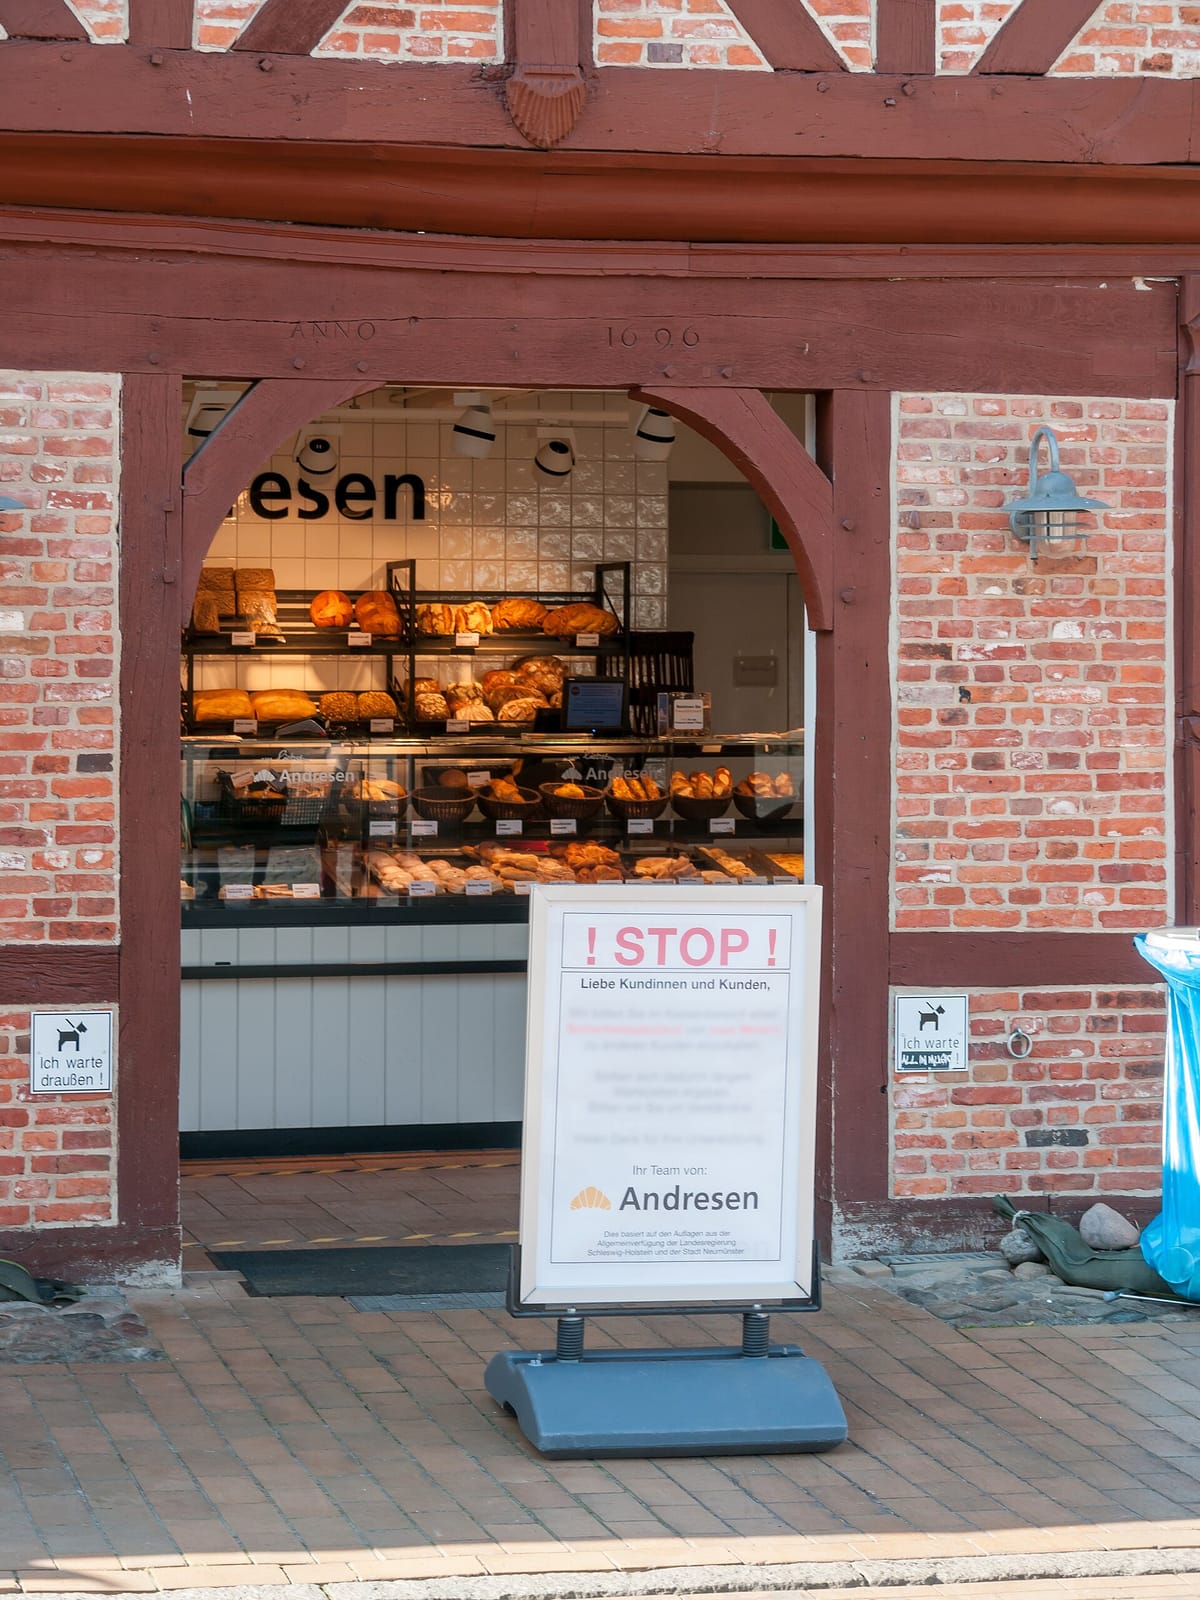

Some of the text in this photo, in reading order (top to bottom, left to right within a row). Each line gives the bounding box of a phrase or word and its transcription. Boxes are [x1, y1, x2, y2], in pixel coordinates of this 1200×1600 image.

[290, 321, 700, 352] ANNO 1696
[229, 471, 426, 520] esen
[587, 926, 777, 967] ! STOP !
[581, 978, 771, 991] Liebe Kundinnen und Kunden,
[903, 1036, 960, 1049] Ich warte
[40, 1057, 104, 1069] Ich warte
[41, 1072, 103, 1087] draußen !
[632, 1164, 708, 1176] Ihr Team von:
[618, 1184, 759, 1211] Andresen
[603, 1230, 620, 1238] Dies
[620, 1230, 645, 1238] basiert
[646, 1230, 657, 1238] auf
[658, 1230, 672, 1238] den
[673, 1229, 704, 1238] Auflagen
[666, 1239, 678, 1247] der
[679, 1239, 737, 1248] Landesregierung
[587, 1247, 745, 1258] Schleswig-Holstein und der Stadt Neumünster
